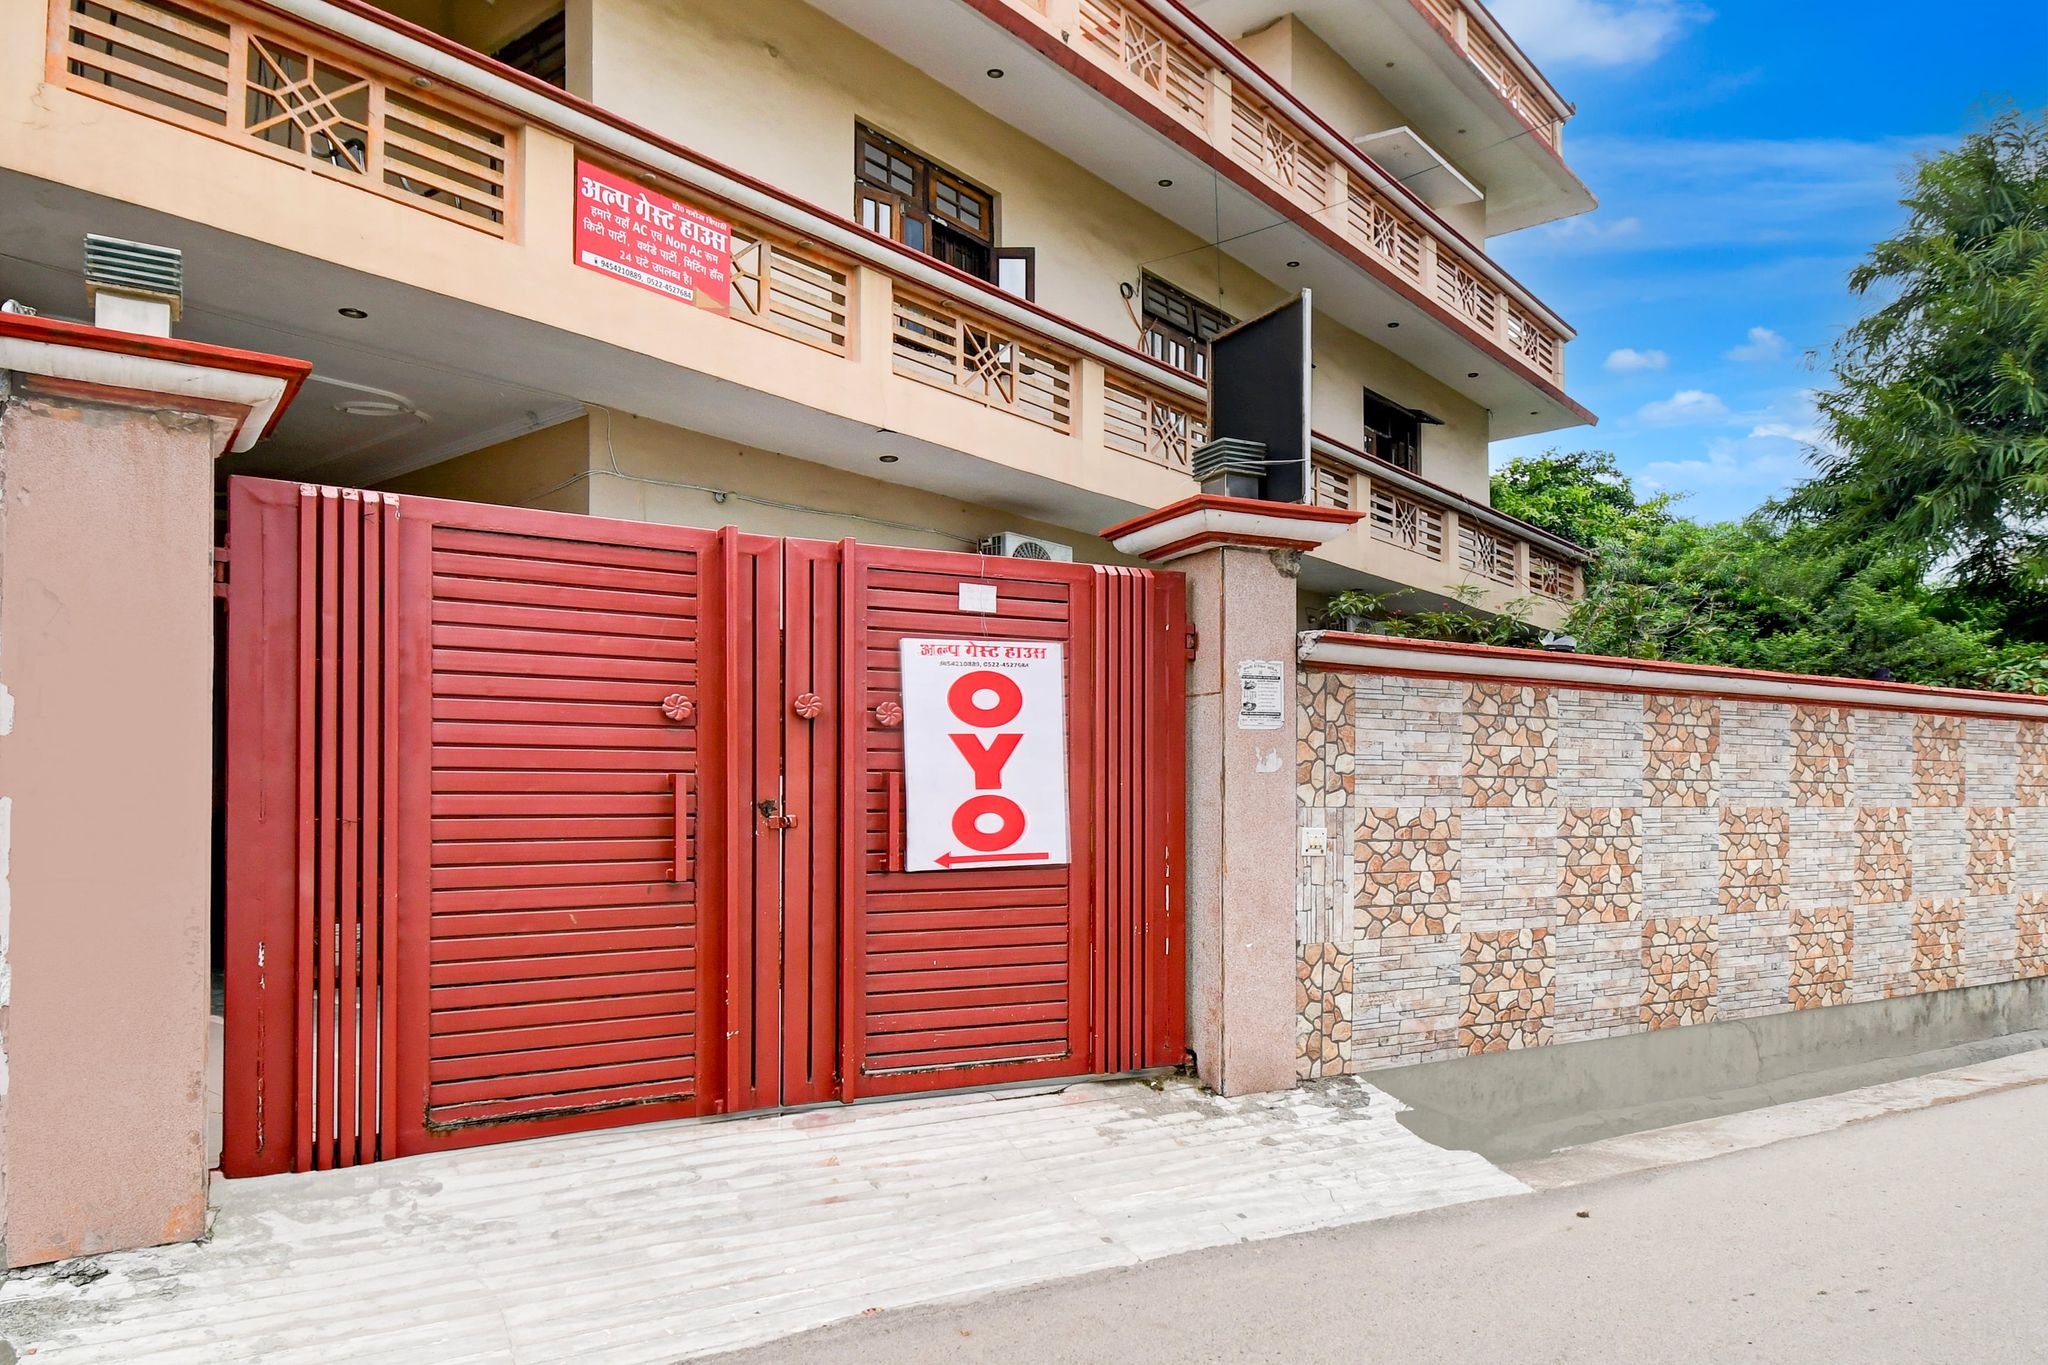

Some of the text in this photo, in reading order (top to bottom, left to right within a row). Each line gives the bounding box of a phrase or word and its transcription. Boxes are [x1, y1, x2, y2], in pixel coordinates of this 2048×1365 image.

[581, 176, 728, 253] अल्प गेस्ट हाउस
[590, 205, 612, 221] हमारे
[632, 223, 648, 237] AC
[650, 228, 663, 243] एवं
[666, 236, 687, 251] Non
[689, 247, 702, 258] Ac
[704, 251, 719, 265] रूम
[583, 218, 605, 237] किटी
[709, 266, 724, 283] हॉल
[619, 250, 632, 263] 24
[635, 254, 649, 269] घंटे
[651, 262, 681, 281] उपलब्ध
[646, 277, 692, 299] 0522-4527684
[964, 641, 1001, 658] गेस्ट
[1003, 647, 1047, 659] हाउस
[947, 670, 1026, 852] OYO
